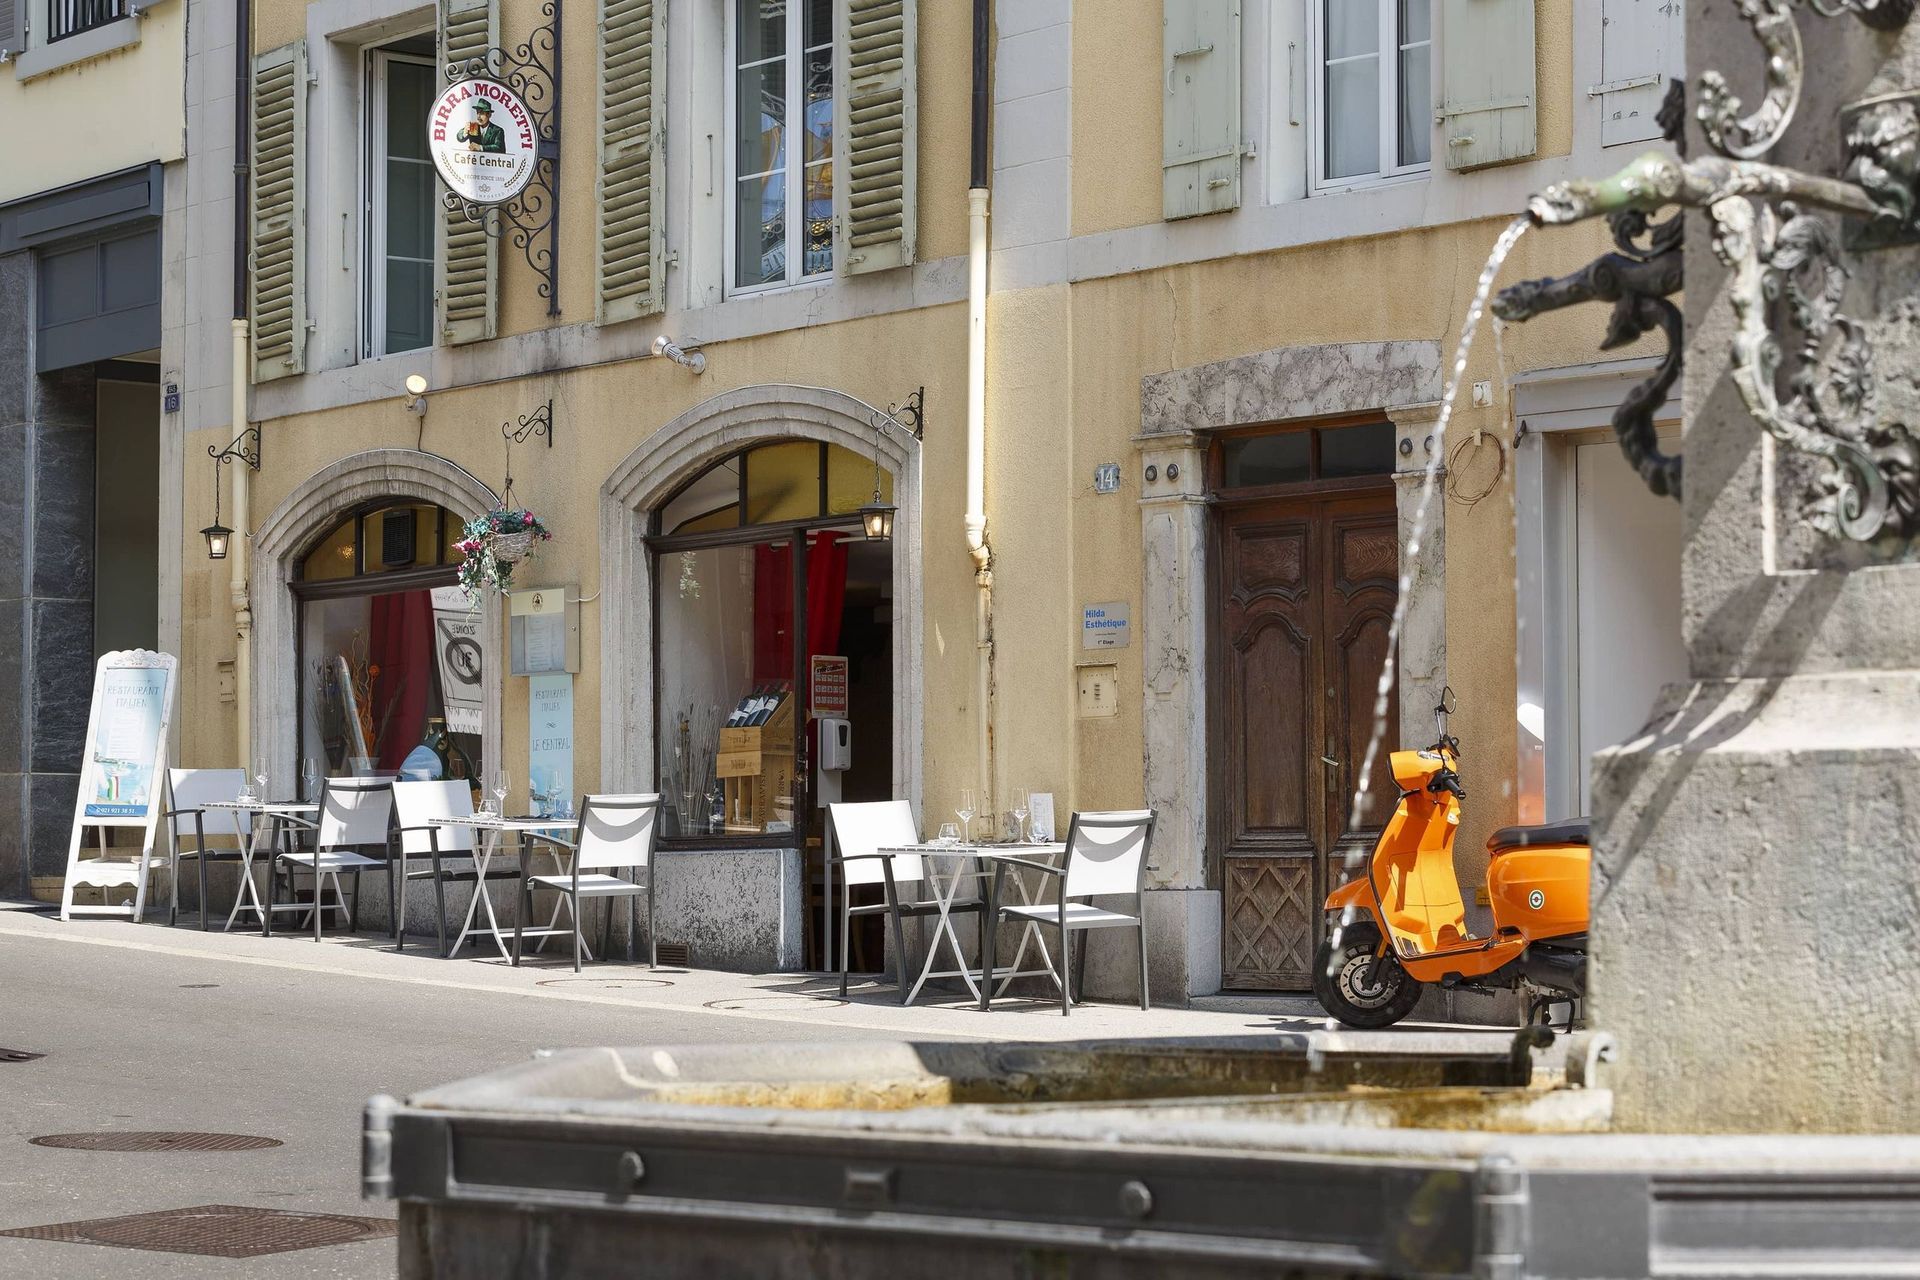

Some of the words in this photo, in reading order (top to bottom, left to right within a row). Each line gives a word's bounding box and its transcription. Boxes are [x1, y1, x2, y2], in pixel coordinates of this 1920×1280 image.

[434, 86, 473, 142] BIRRA
[474, 83, 533, 149] MORETTI
[454, 153, 477, 166] Café
[479, 155, 515, 169] Central
[168, 397, 176, 410] 16
[1097, 468, 1115, 490] 14
[1086, 609, 1105, 618] Hilda
[107, 686, 160, 696] RESTAURANT
[116, 698, 147, 707] ITALIEN
[532, 739, 541, 752] LE
[542, 737, 570, 751] CENTRAL
